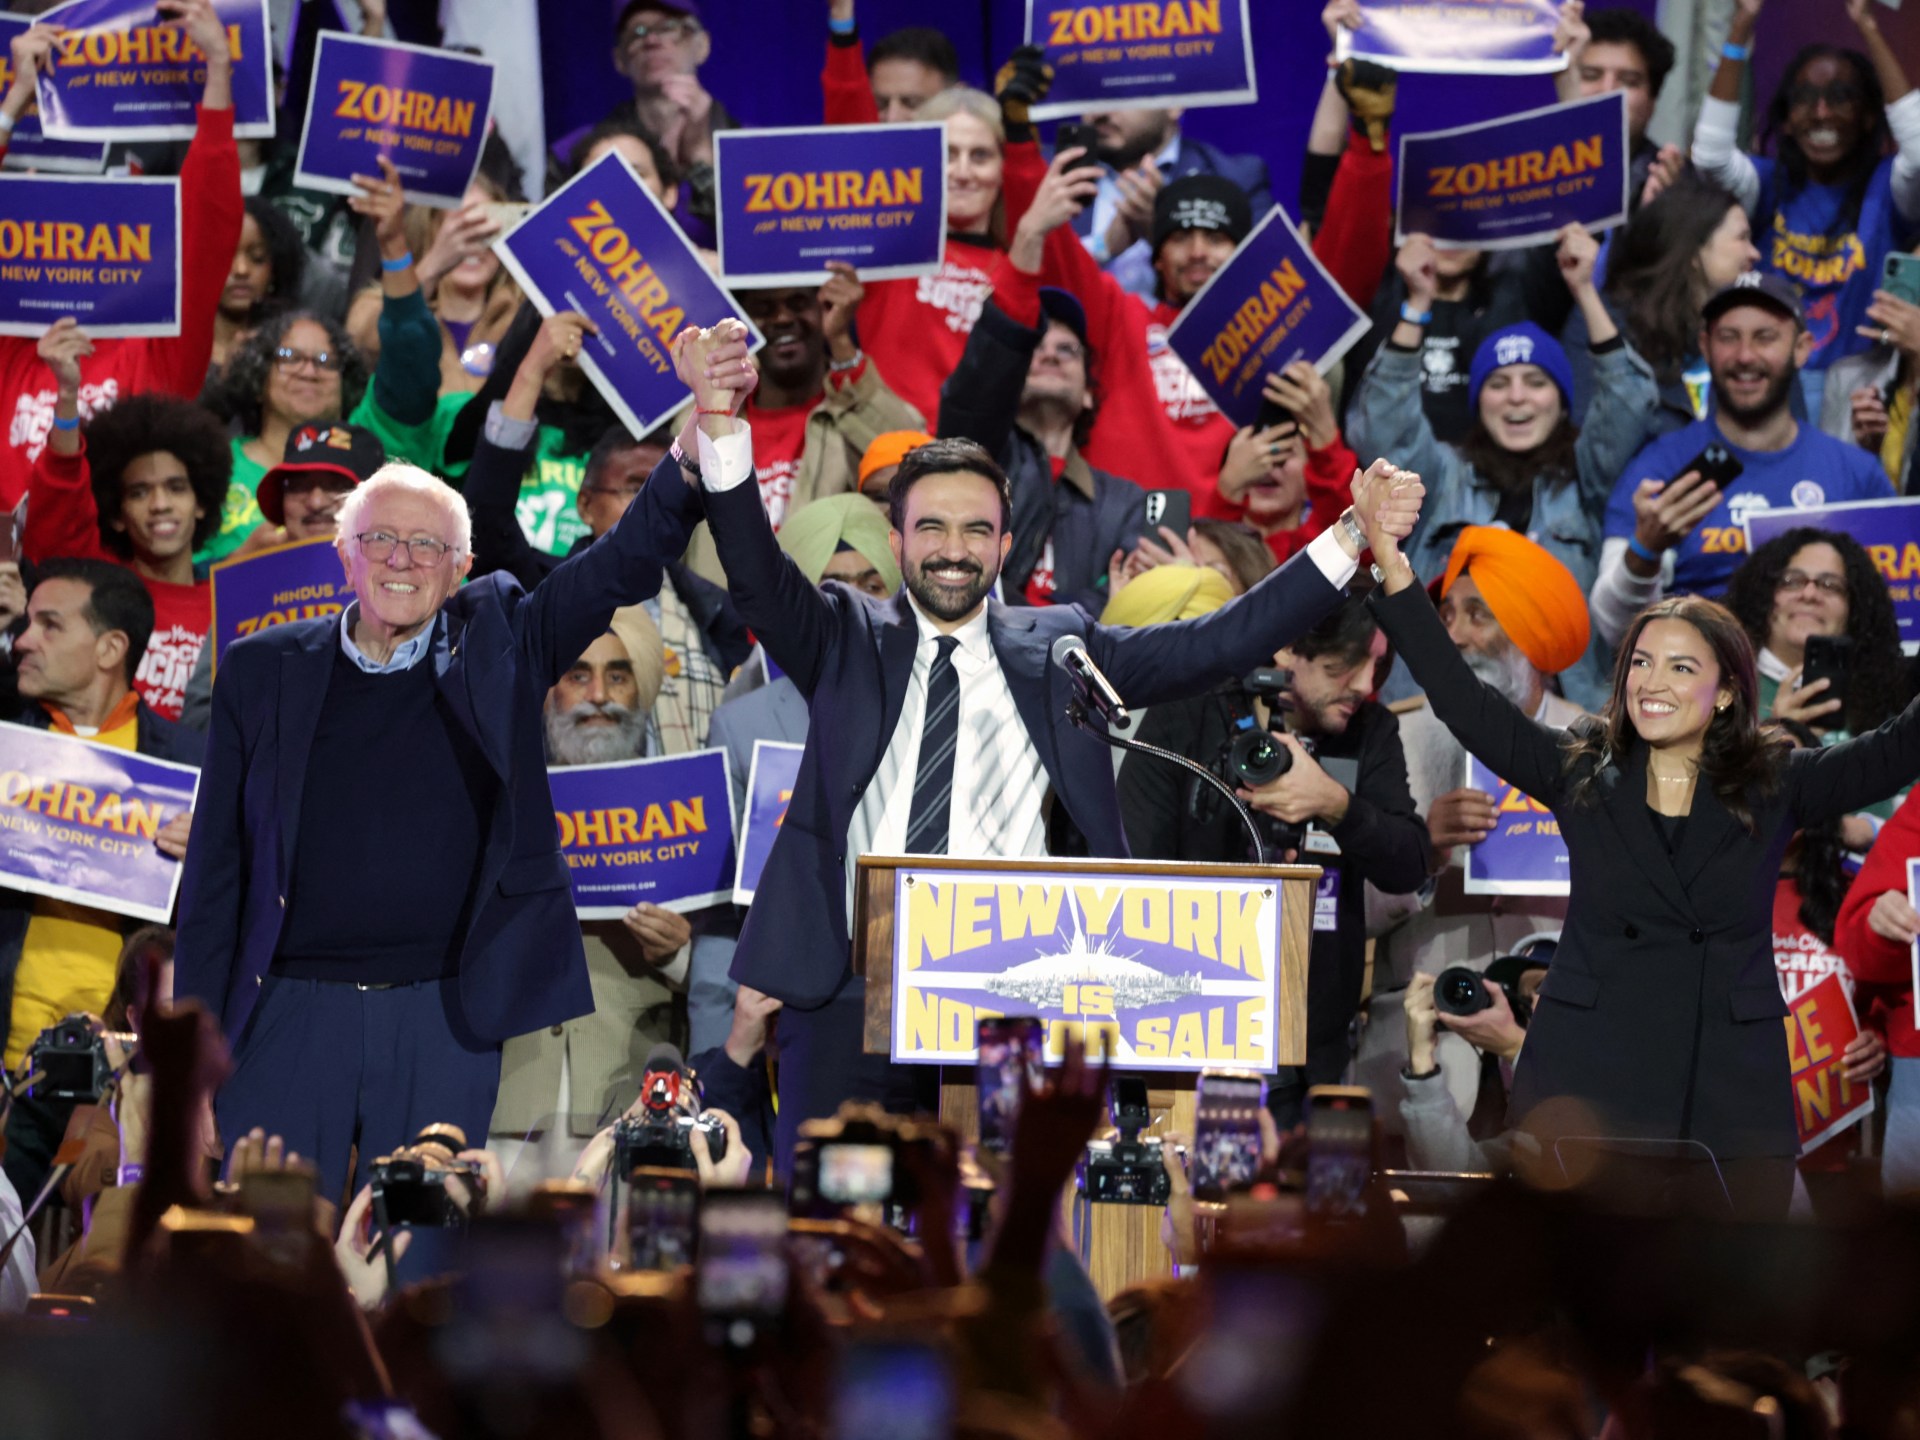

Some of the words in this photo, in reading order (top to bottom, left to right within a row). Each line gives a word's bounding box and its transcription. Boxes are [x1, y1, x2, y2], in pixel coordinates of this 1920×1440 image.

[1048, 0, 1222, 47] ZOHRAN
[95, 71, 138, 86] NEW
[141, 69, 189, 85] YORK
[335, 79, 476, 139] ZOHRAN
[1427, 134, 1604, 197] ZOHRAN
[743, 167, 923, 213] ZOHRAN
[0, 219, 152, 262] OHRAN
[781, 216, 824, 233] NEW
[828, 212, 873, 230] YORK
[876, 210, 914, 229] CITY
[1, 264, 41, 282] NEW
[45, 267, 95, 284] YORK
[99, 268, 142, 284] CITY
[567, 199, 692, 353] ZOHRA
[574, 257, 610, 297] NEW
[605, 293, 644, 344] YORK
[637, 337, 671, 375] CITY
[1200, 256, 1306, 387] ZOHRAN
[273, 583, 335, 606] HINDUS
[0, 770, 165, 840] OHRAN
[555, 796, 708, 848] OHRAN
[1536, 820, 1562, 836] NE
[0, 814, 41, 835] NEW
[46, 825, 97, 848] YORK
[100, 838, 145, 859] CITY
[601, 847, 654, 867] YORK
[657, 841, 701, 862] CITY
[907, 882, 1066, 972] NEW
[1074, 884, 1266, 982] YORK
[1062, 984, 1114, 1016] IS
[905, 986, 1004, 1052] NO
[1135, 995, 1265, 1061] SALE
